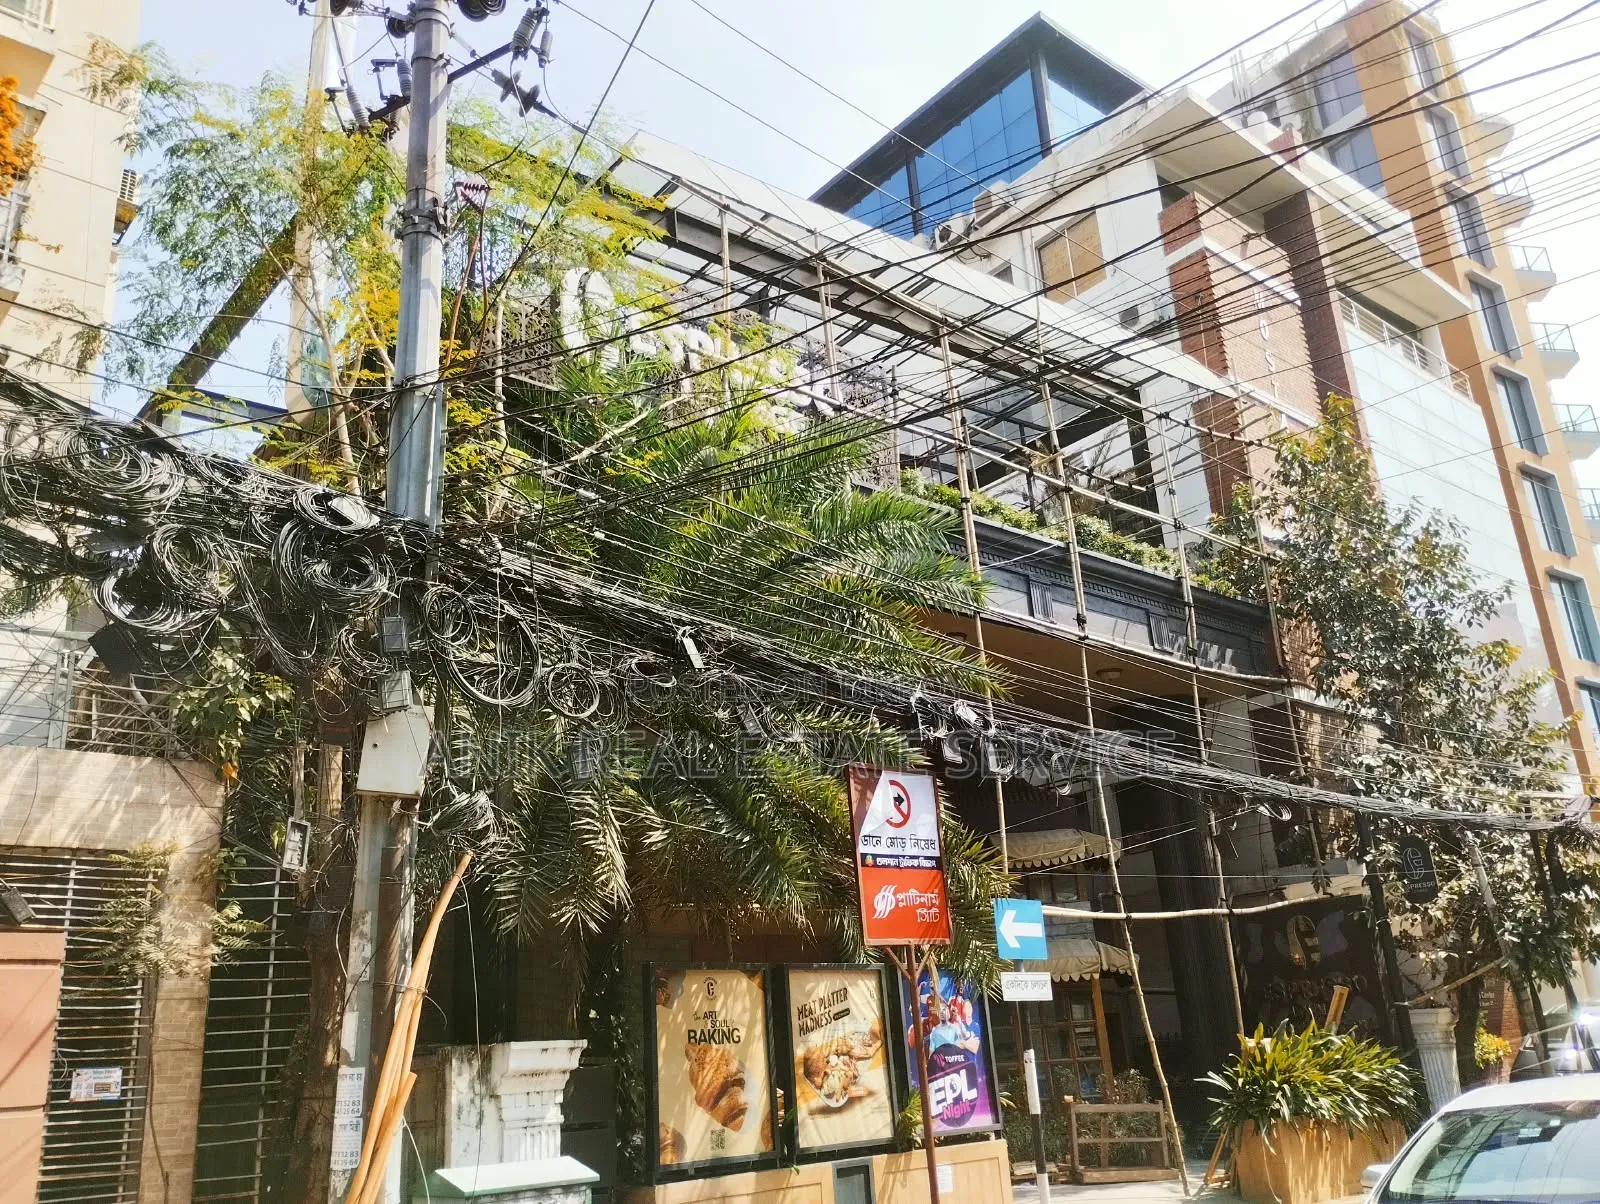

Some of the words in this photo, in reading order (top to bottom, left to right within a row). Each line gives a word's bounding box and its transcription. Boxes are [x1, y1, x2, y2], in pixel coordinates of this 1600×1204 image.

[861, 834, 882, 848] ডানে
[886, 836, 906, 852] মোড়
[909, 833, 936, 850] নিষেধ
[916, 907, 940, 923] সিটি
[797, 1000, 817, 1020] MEAT
[818, 987, 848, 1011] PLATTER
[703, 1011, 718, 1020] ART
[710, 1019, 730, 1028] SOUL
[798, 1010, 833, 1037] MADNESS
[688, 1027, 741, 1045] BAKING
[945, 1055, 965, 1063] TOFFEE
[929, 1069, 978, 1117] EPL
[943, 1100, 970, 1119] Night
